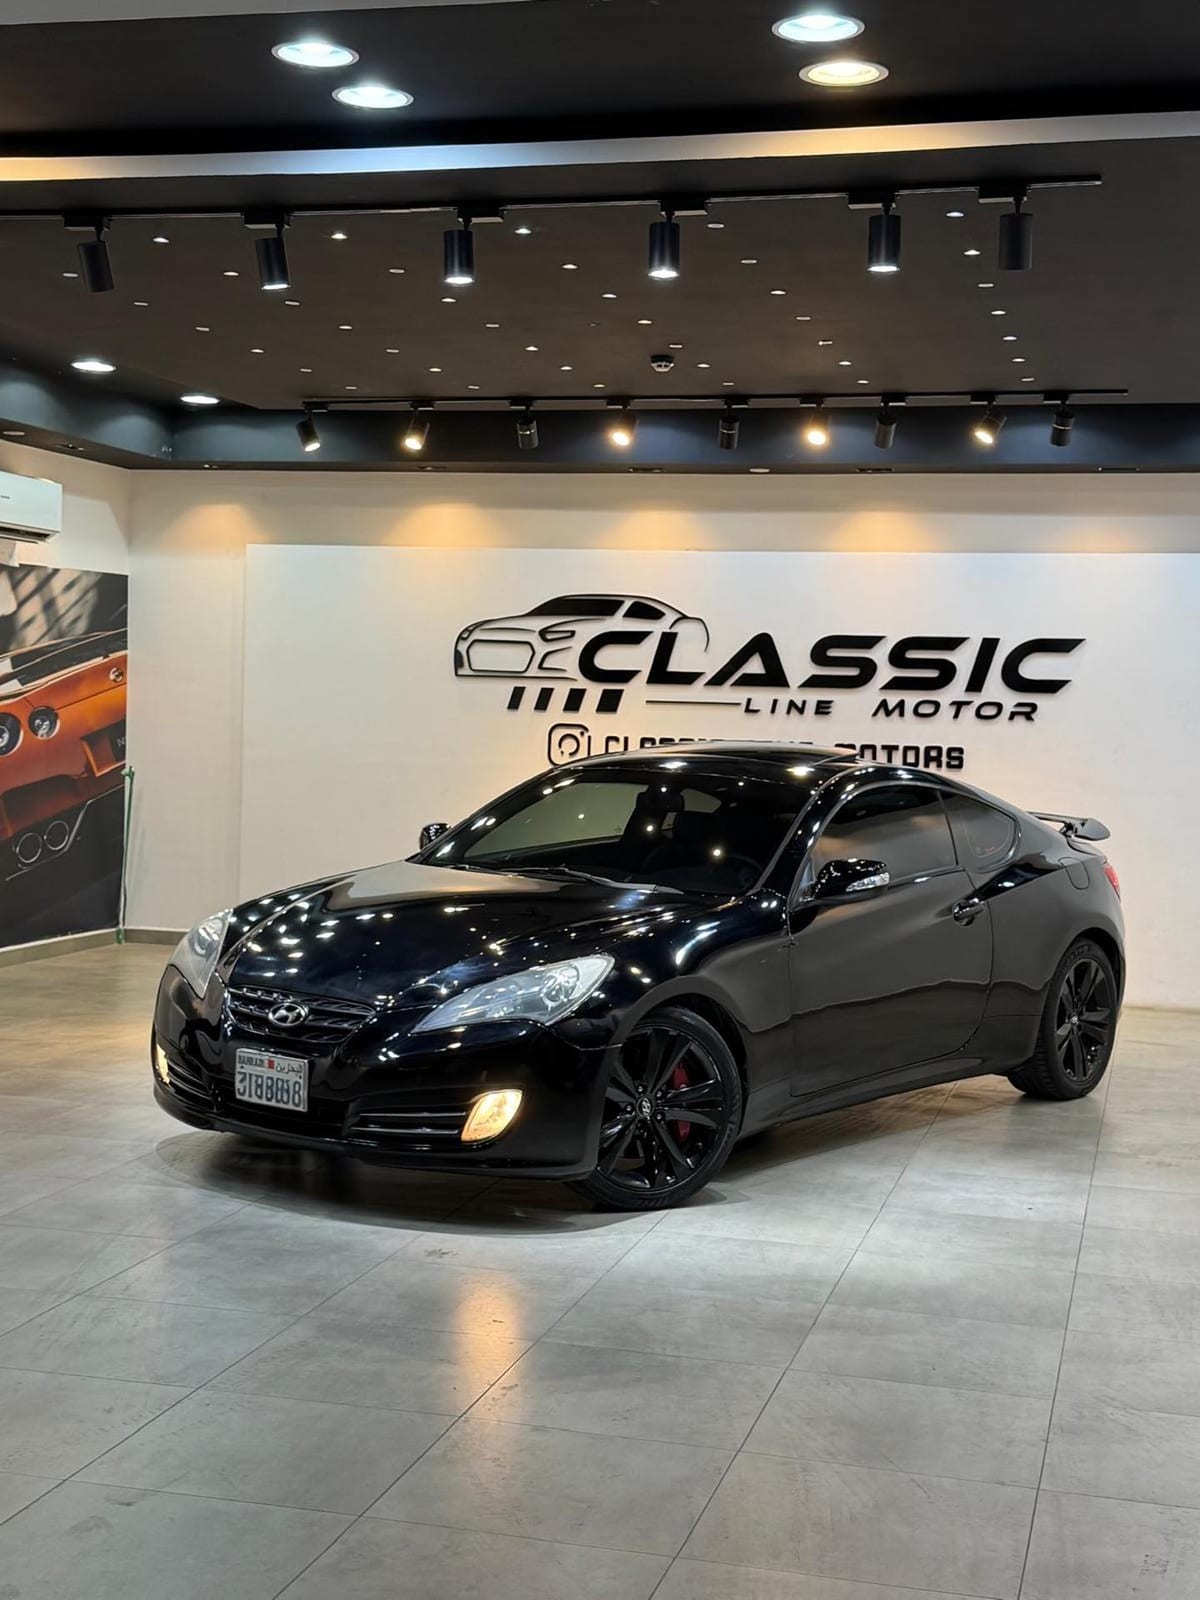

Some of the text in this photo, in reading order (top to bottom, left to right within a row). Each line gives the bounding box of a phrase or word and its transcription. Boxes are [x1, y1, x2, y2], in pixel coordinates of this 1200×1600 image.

[578, 630, 1087, 694] CLASSIC
[743, 697, 1039, 722] LINE MOTOR
